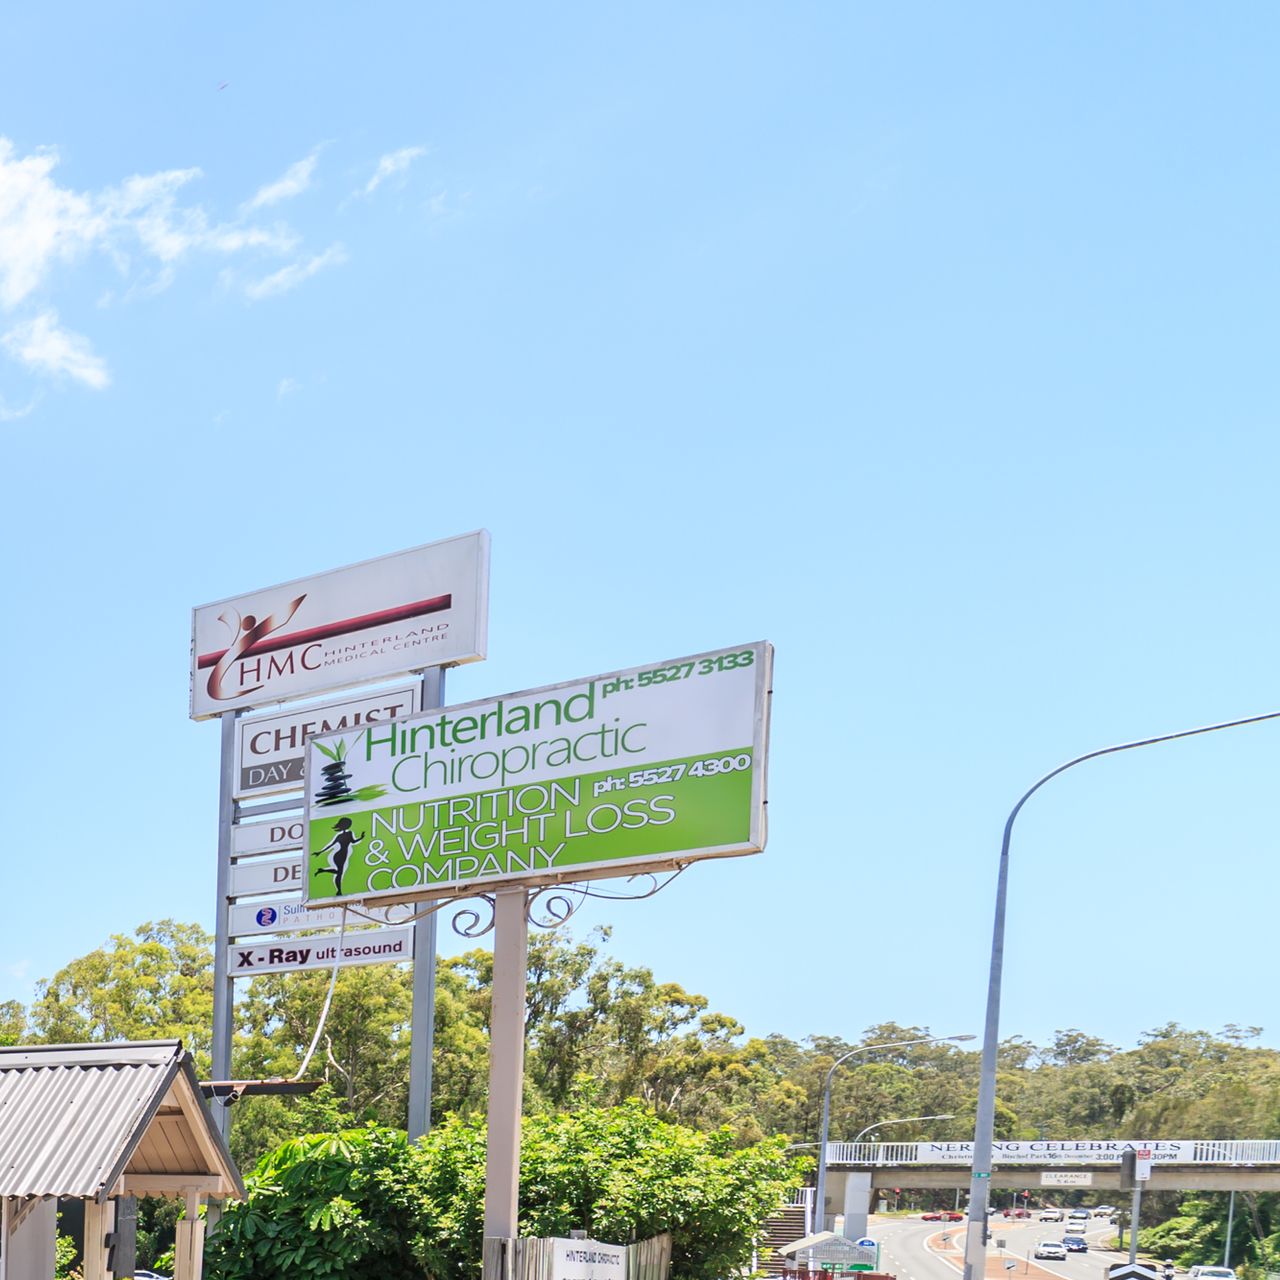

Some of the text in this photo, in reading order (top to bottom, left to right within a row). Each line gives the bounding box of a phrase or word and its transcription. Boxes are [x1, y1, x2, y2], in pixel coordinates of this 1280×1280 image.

[323, 623, 449, 657] HINTERLAND
[324, 632, 449, 667] MEDICAL CENTRE
[239, 643, 322, 686] HMC
[602, 649, 754, 699] ph: 5527 3133
[366, 681, 595, 762] Hinterland
[248, 763, 292, 786] DAY
[391, 718, 647, 793] Chiropractic
[592, 753, 752, 798] ph: 5527 4300
[364, 795, 676, 866] & WEIGHT LOSS
[370, 778, 581, 839] NUTRITION
[366, 842, 568, 892] COMPANY
[930, 1142, 1181, 1152] NERNG CELEBRATES
[1095, 1153, 1115, 1161] 3:00
